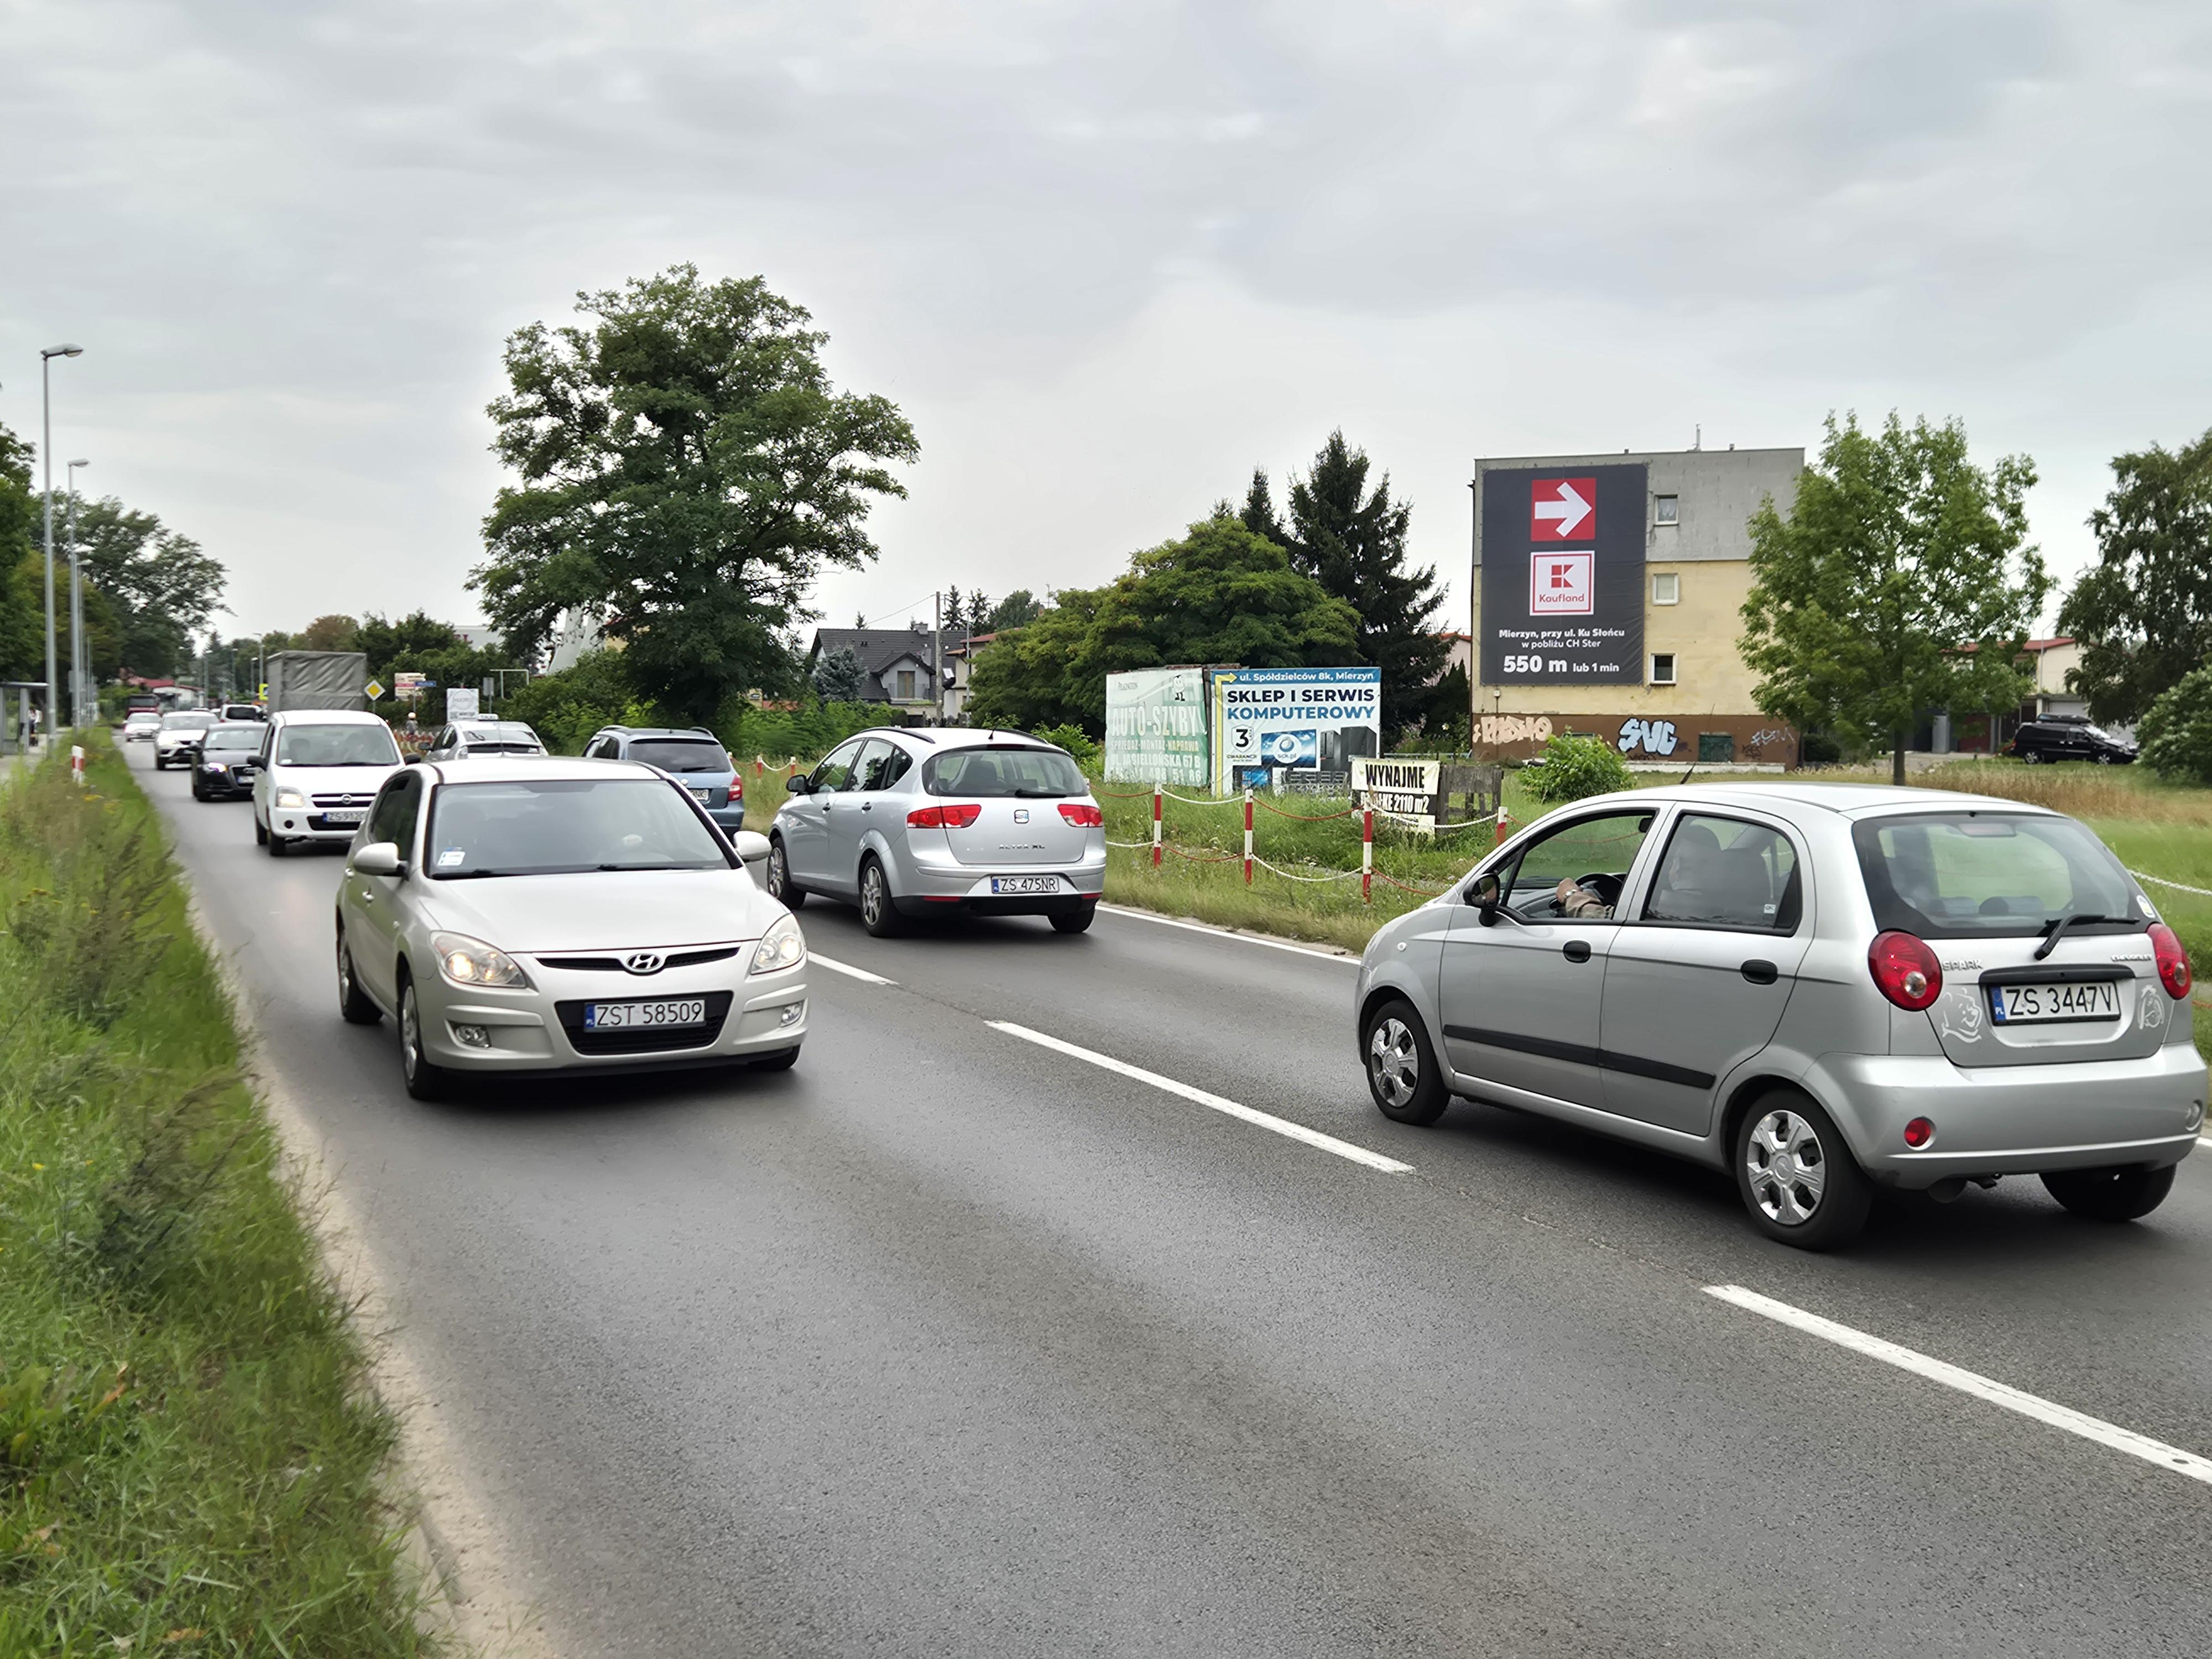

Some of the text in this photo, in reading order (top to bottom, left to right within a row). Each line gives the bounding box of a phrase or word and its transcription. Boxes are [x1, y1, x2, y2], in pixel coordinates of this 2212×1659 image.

[1539, 593, 1584, 602] Kaufland
[1499, 629, 1538, 638] Mierzyn,
[1541, 630, 1562, 639] przy
[1593, 628, 1625, 637] Słońcu
[1531, 640, 1564, 649] pobliżu
[1582, 639, 1601, 648] Ster
[1504, 655, 1619, 672] 550 m lub 1 min
[1240, 671, 1374, 683] ul. Spółdzielców 8k, Mierzyn
[1227, 689, 1374, 703] SKLEP I SERWIS
[1228, 706, 1375, 719] KOMPUTEROWY
[1112, 706, 1197, 736] AUTO-SZYBY
[1235, 729, 1249, 747] 3
[1194, 755, 1201, 769] B
[1365, 764, 1425, 792] WYNAJMĘ
[1394, 793, 1414, 812] 2110
[1415, 795, 1430, 813] m2
[1001, 878, 1055, 891] ZS 475NR
[1942, 959, 1984, 972] SPARK
[2006, 985, 2111, 1016] ZS 3447V
[597, 1002, 702, 1026] ZST 58509
